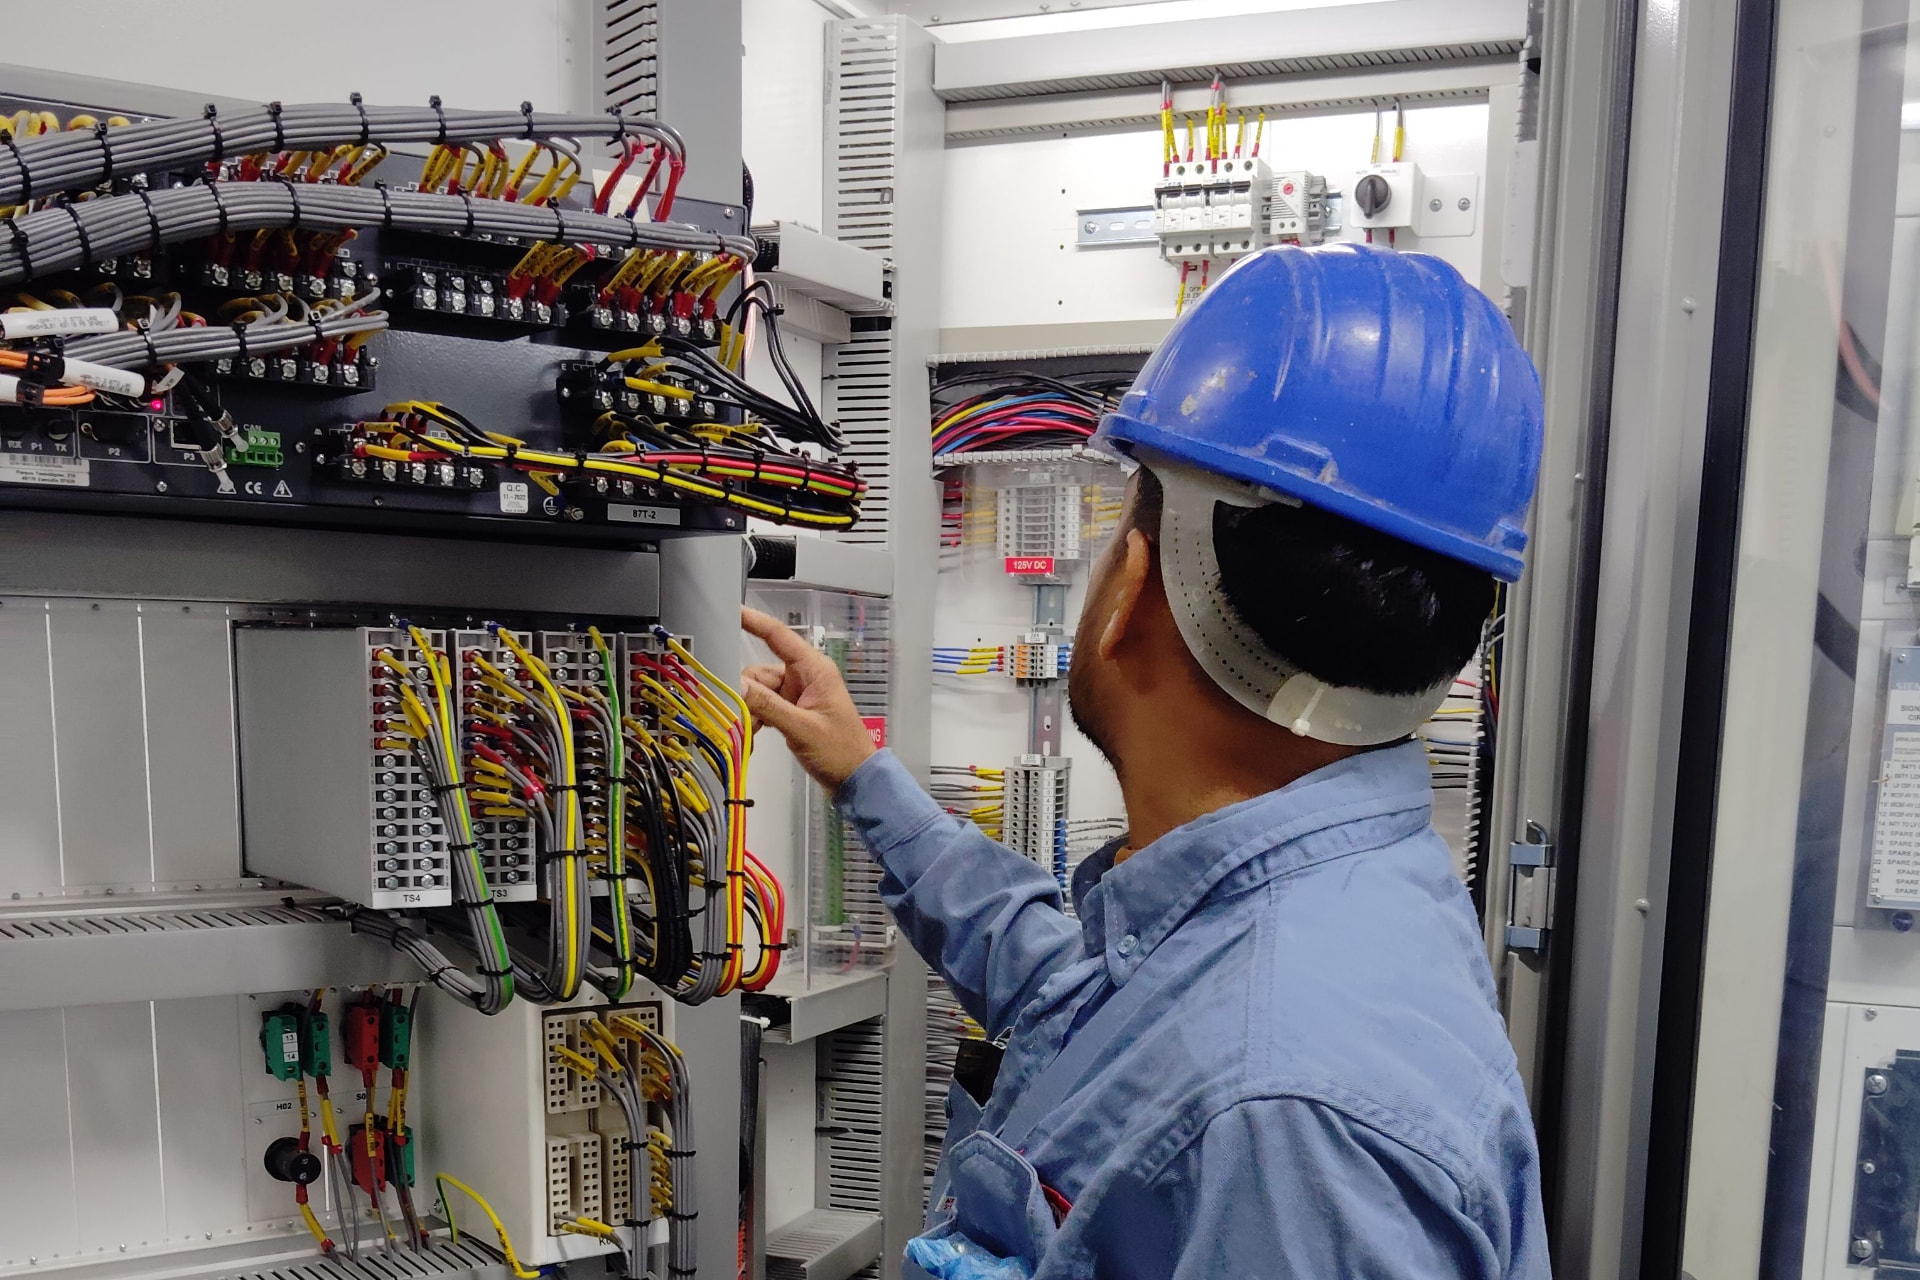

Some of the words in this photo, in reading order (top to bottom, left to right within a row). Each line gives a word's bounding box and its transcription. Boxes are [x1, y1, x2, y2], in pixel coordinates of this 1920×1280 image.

[8, 440, 22, 449] RX
[31, 442, 43, 451] P1
[54, 443, 68, 452] TX
[108, 447, 121, 456] P2
[183, 452, 195, 461] P3
[632, 509, 656, 519] 87T-2
[1013, 561, 1033, 570] 125V
[1034, 560, 1047, 569] DC
[491, 889, 508, 898] TS3
[1895, 887, 1919, 895] SPARE
[276, 1102, 292, 1110] H02
